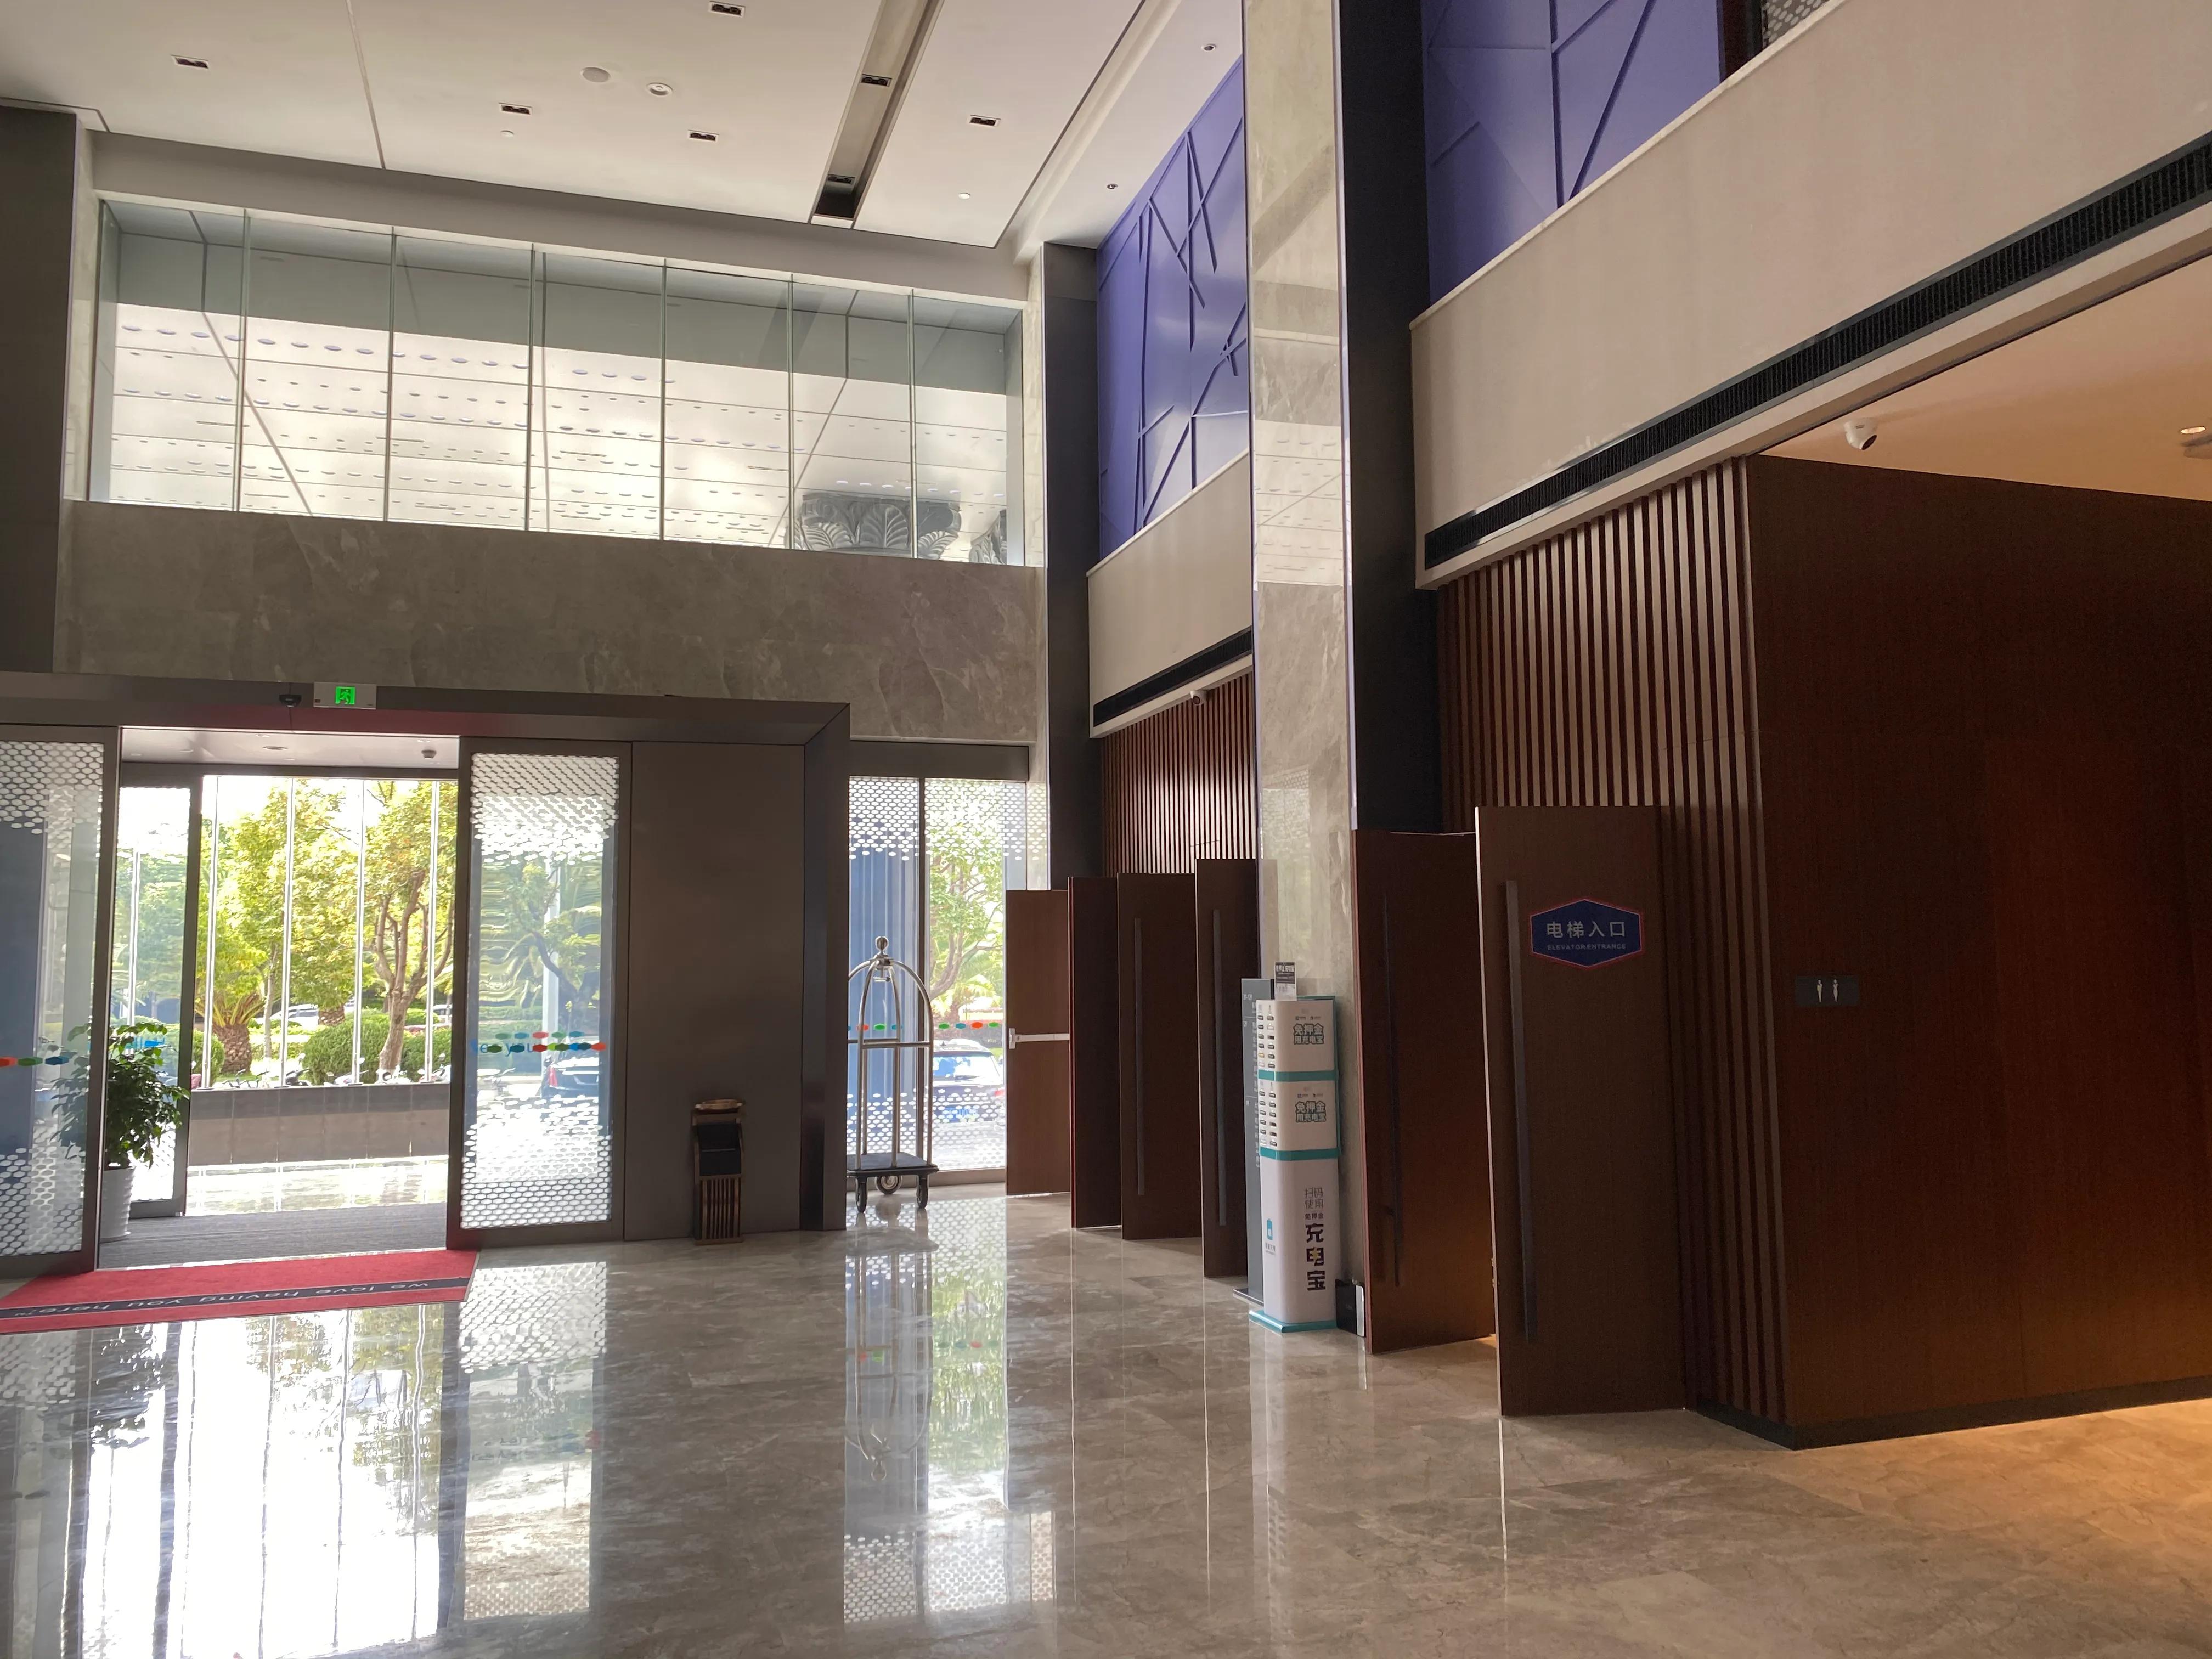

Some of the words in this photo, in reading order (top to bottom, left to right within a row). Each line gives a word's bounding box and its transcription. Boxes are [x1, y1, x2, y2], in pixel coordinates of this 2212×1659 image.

[1547, 921, 1625, 938] 电梯入口
[1293, 1023, 1323, 1035] 免押金
[1295, 1101, 1325, 1113] 免押金
[1304, 1187, 1323, 1198] 扫码
[1305, 1199, 1324, 1209] 使用
[1305, 1223, 1326, 1291] 充电宝
[315, 1286, 374, 1294] love
[199, 1291, 299, 1302] having
[127, 1298, 184, 1308] you
